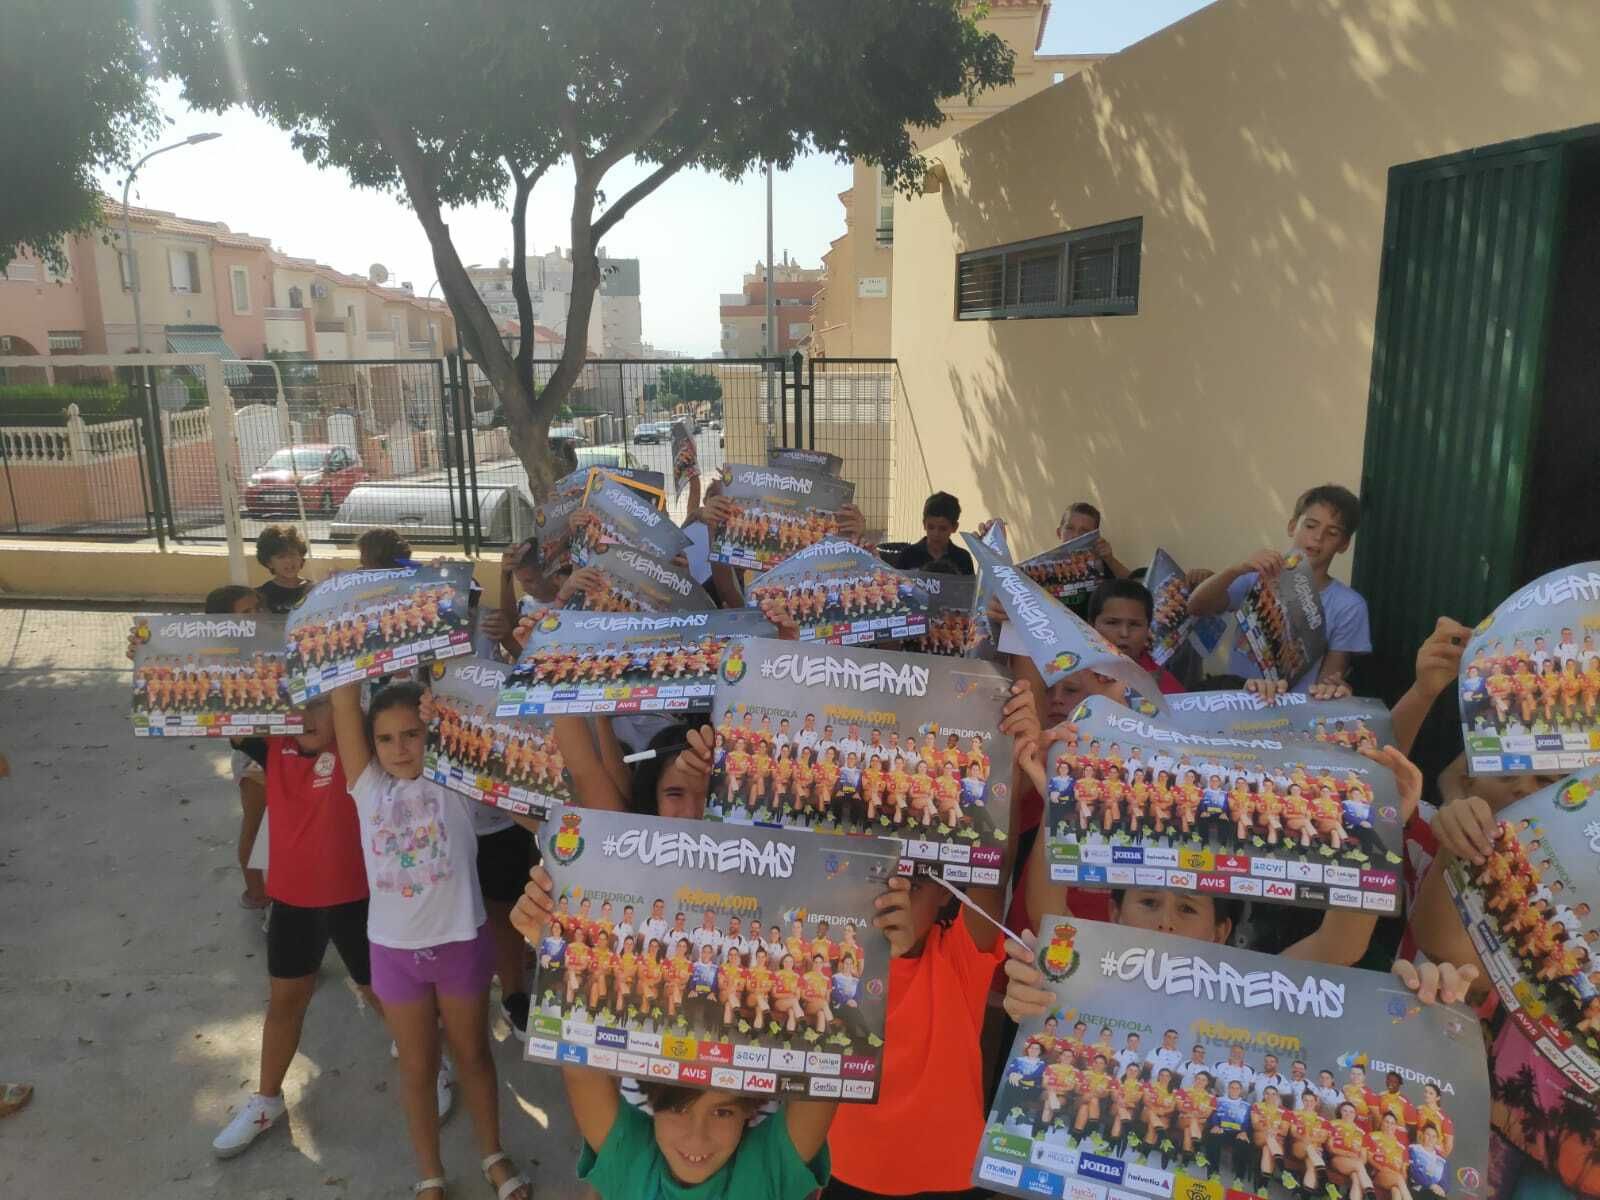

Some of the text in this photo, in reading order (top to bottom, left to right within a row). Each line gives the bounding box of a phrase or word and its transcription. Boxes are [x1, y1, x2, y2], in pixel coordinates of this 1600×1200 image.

[738, 471, 813, 494] #GUERRERAS
[160, 620, 256, 638] #GUERRERAS
[574, 614, 708, 631] #GUERRERAS
[760, 654, 929, 697] #GUERRERAS
[1170, 692, 1307, 712] #GUERREAS
[939, 726, 992, 740] IBERDROLA
[1106, 711, 1283, 750] #GUERRERAS
[601, 829, 796, 880] #GUERRERAS
[1200, 876, 1225, 888] AVIS
[1362, 873, 1396, 887] renfe
[583, 888, 645, 905] IBERDROLA
[1266, 883, 1293, 897] AON
[807, 913, 868, 930] IBERDROLA
[1101, 947, 1345, 1019] #GUERRERAS
[1078, 1012, 1153, 1034] IBERDROLA
[682, 1065, 707, 1080] AVIS
[843, 1059, 876, 1074] renfe
[746, 1075, 773, 1089] AON
[1370, 1059, 1456, 1096] IBERDROLA
[1127, 1173, 1160, 1187] helvetia
